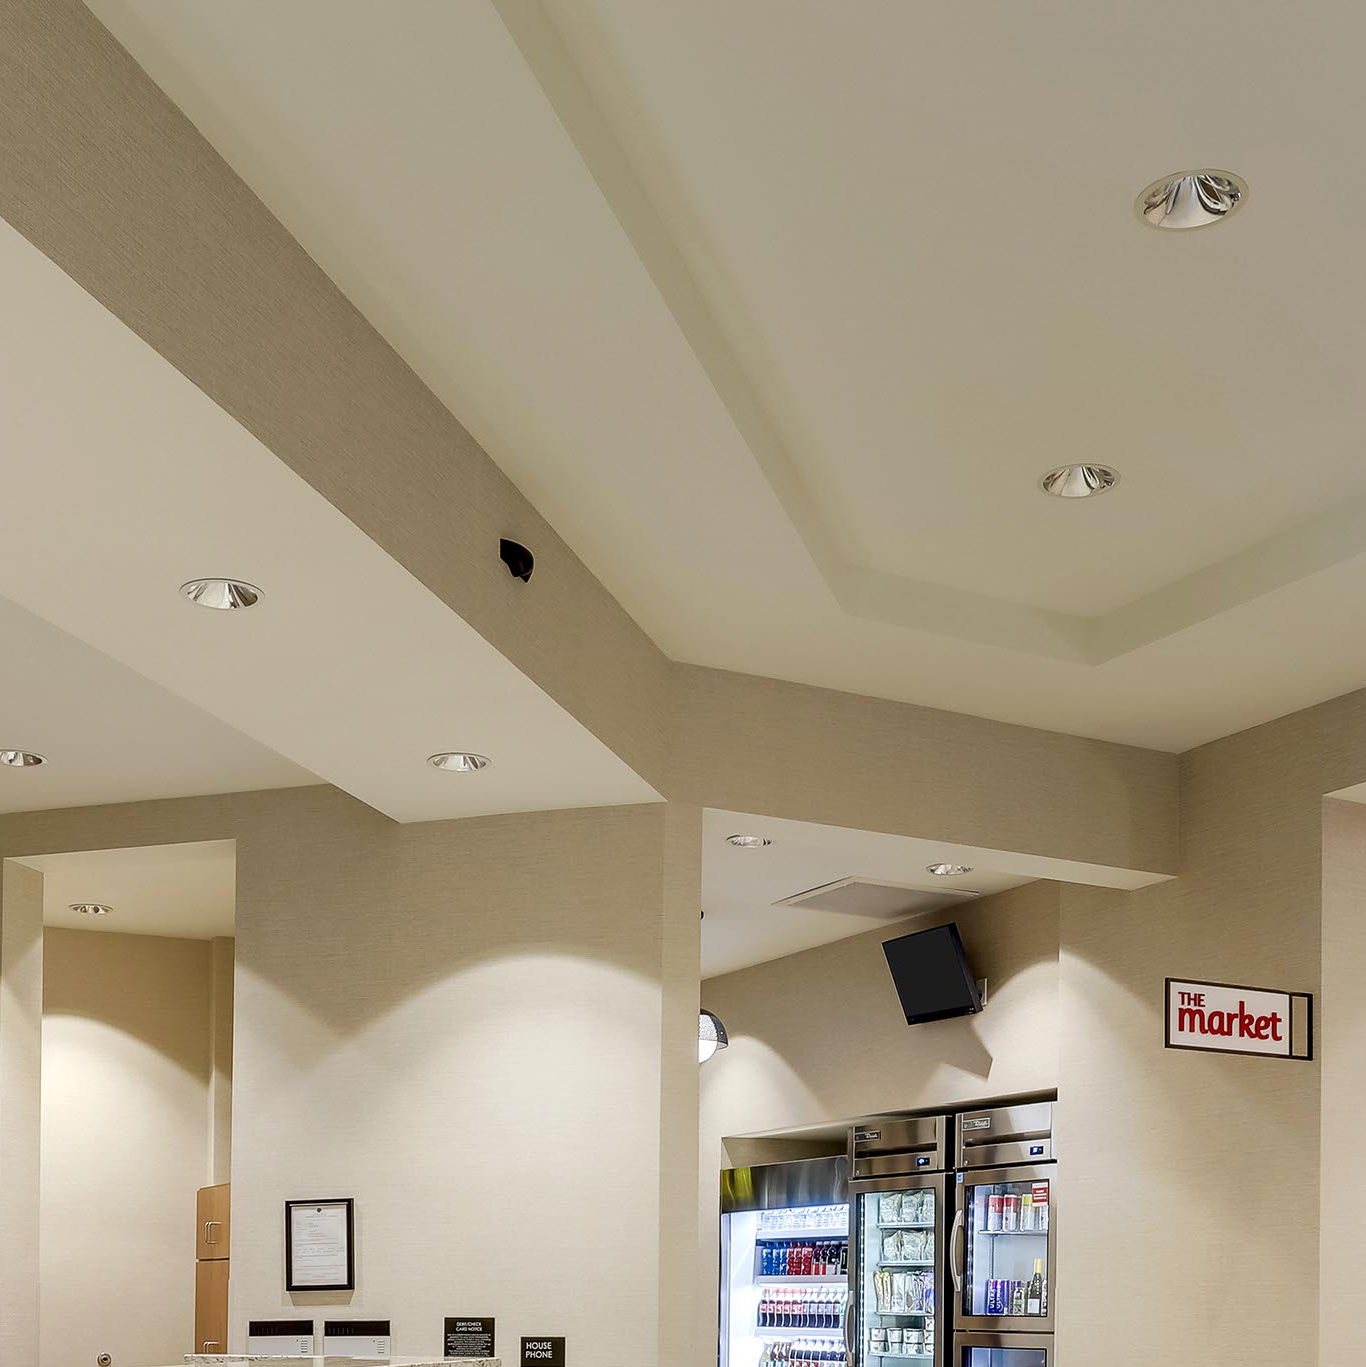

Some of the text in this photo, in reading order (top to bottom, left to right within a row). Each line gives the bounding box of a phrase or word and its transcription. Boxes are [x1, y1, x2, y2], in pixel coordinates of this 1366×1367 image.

[1178, 991, 1206, 1007] THE
[1178, 1000, 1283, 1042] market
[526, 1342, 552, 1350] HOUSE
[525, 1350, 553, 1358] PHONE
